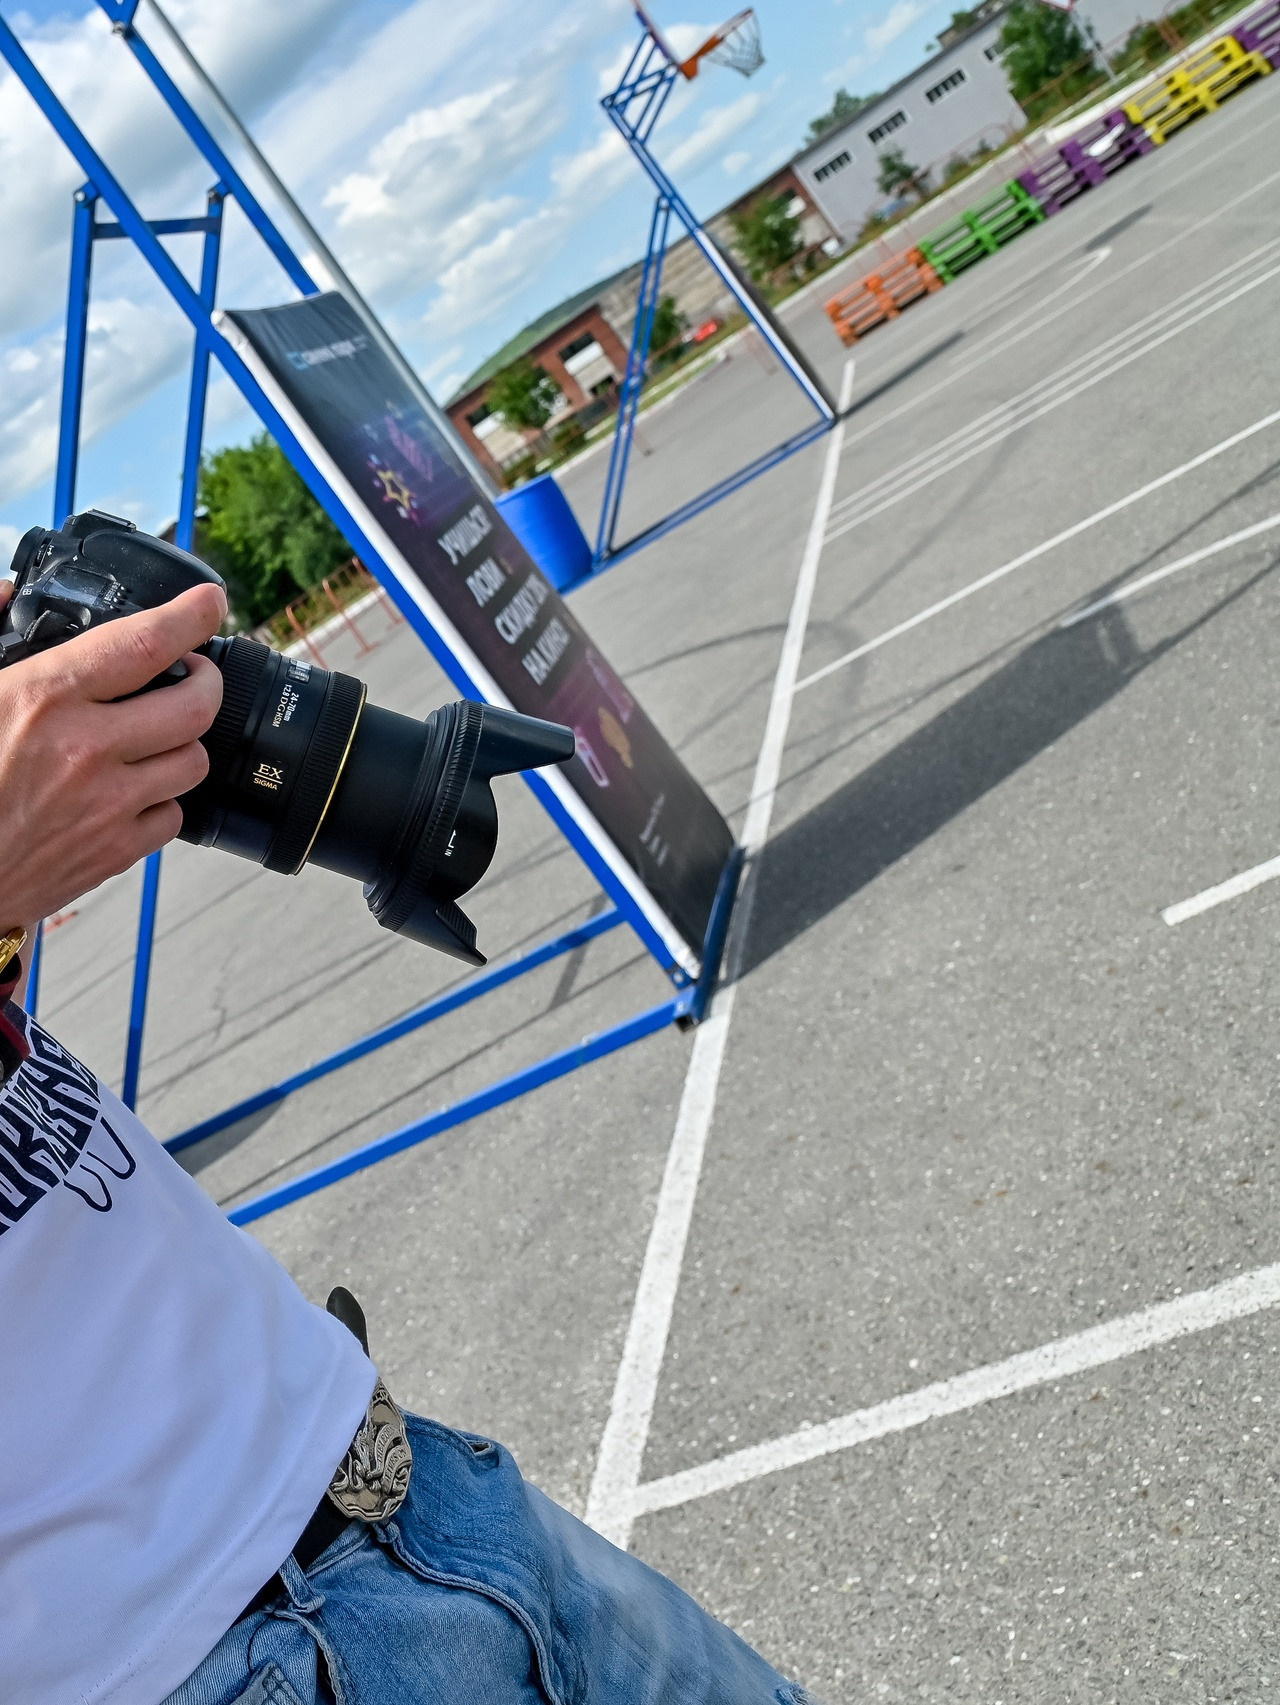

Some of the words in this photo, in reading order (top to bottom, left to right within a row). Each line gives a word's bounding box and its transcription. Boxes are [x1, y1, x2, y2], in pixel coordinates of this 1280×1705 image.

[522, 647, 551, 686] НА
[277, 697, 288, 714] DG
[272, 711, 284, 727] HSM
[258, 763, 283, 780] EX
[254, 778, 278, 790] SIGMA
